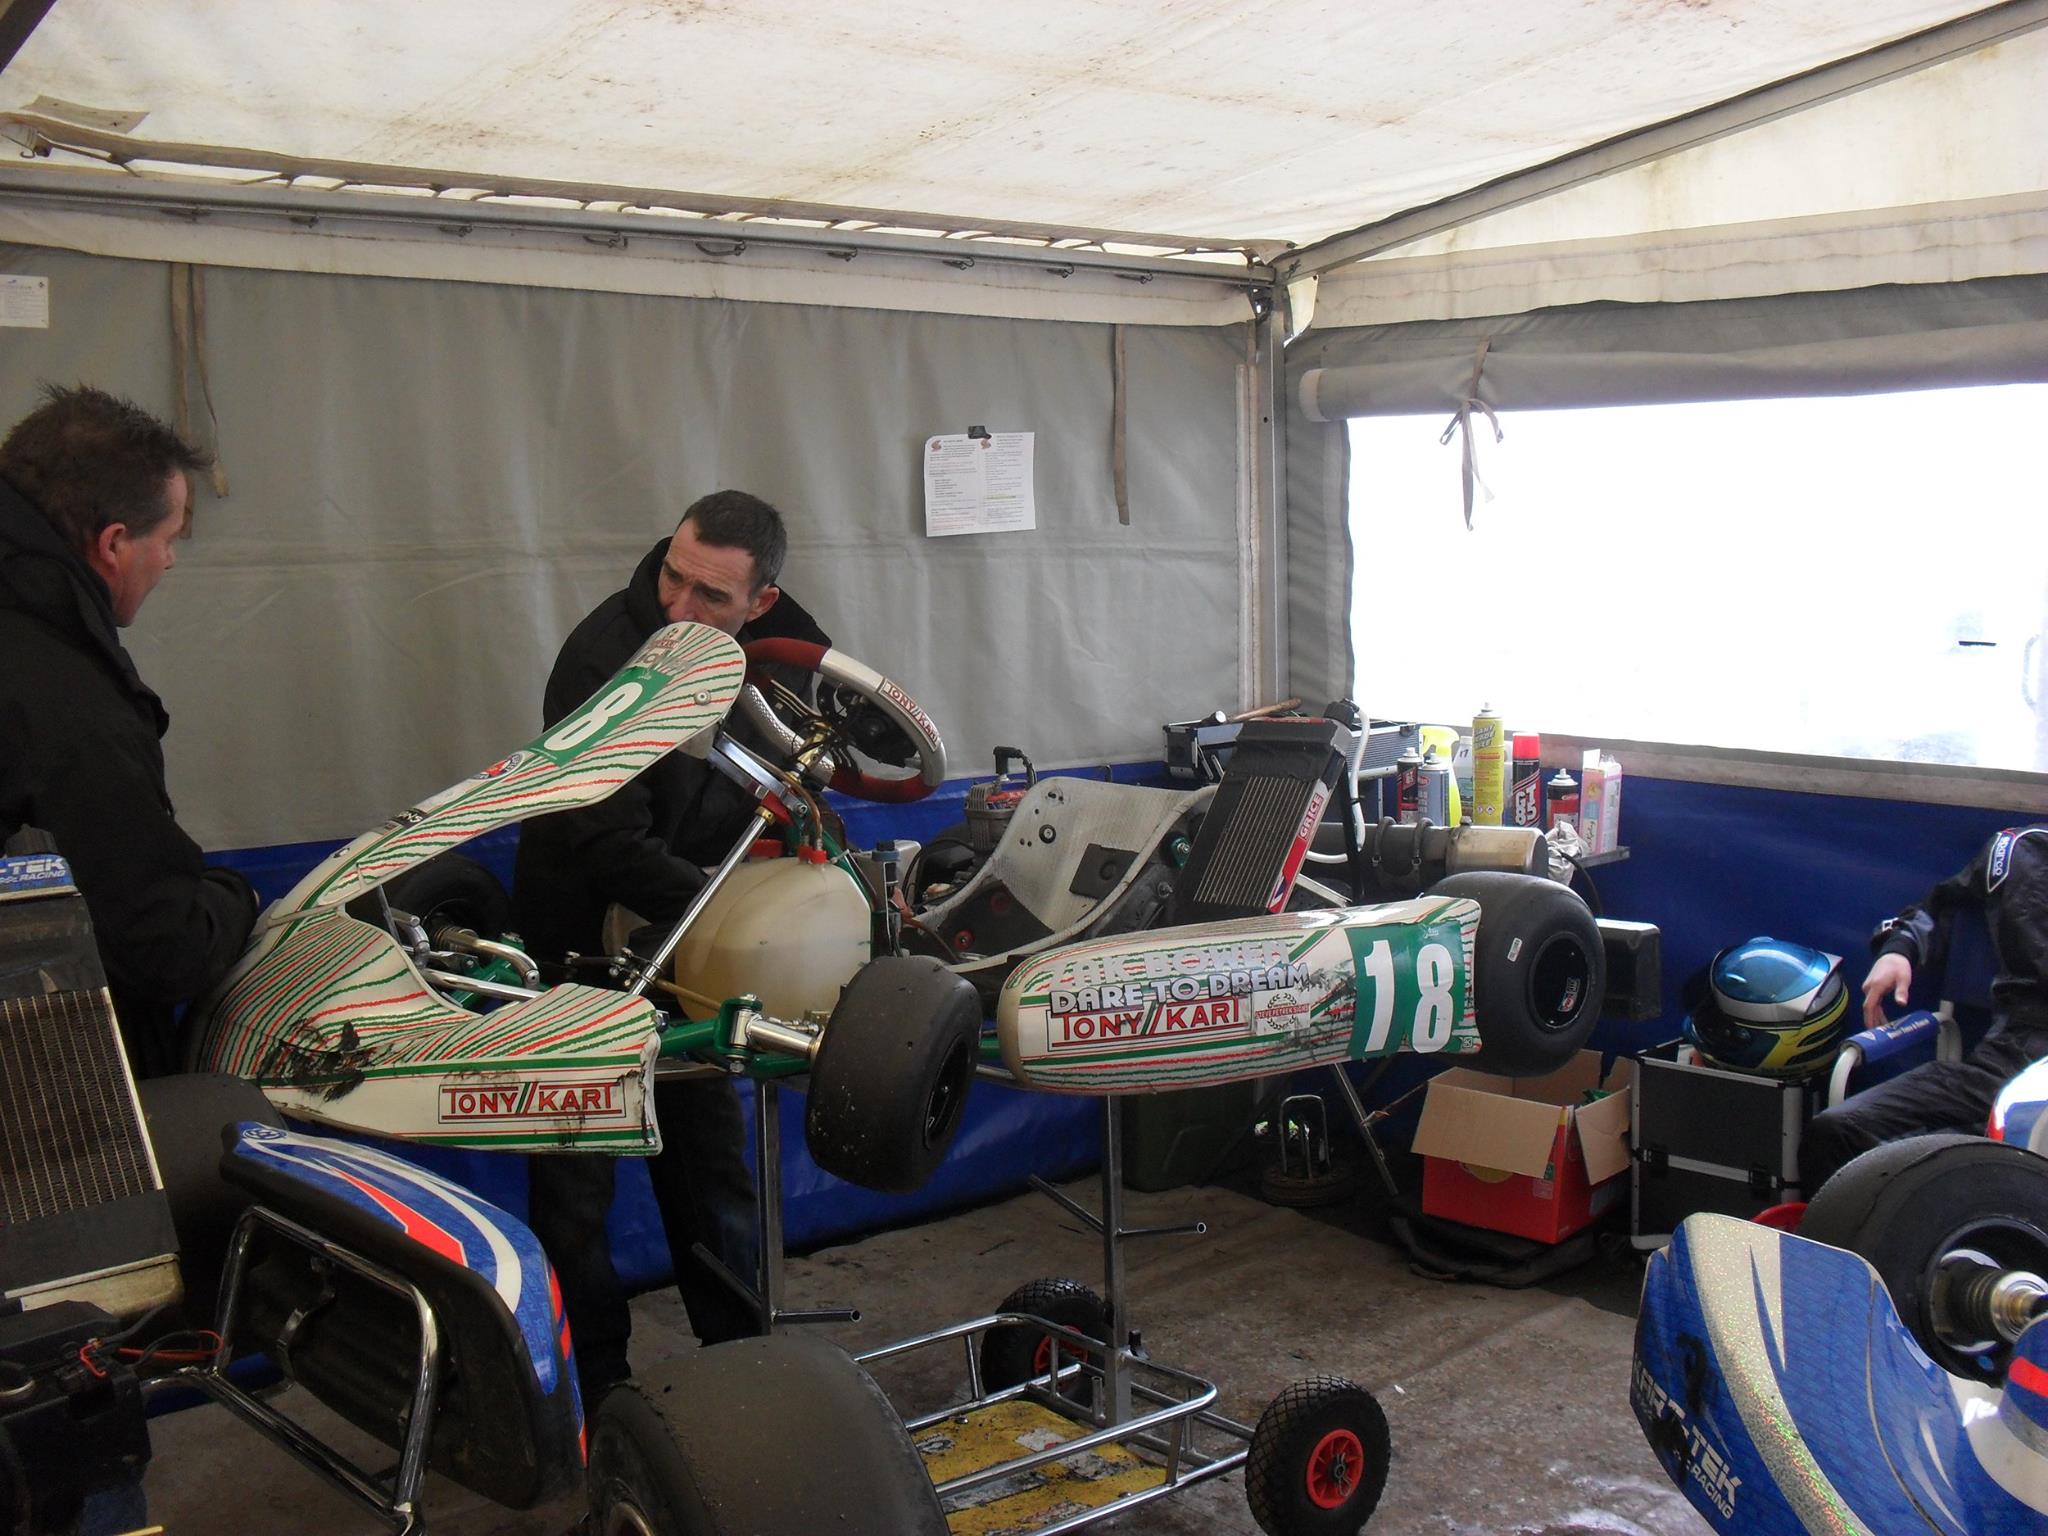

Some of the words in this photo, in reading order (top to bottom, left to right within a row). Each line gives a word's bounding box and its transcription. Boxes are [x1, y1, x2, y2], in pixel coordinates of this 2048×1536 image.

[19, 869, 66, 882] RACING
[1144, 941, 1290, 978] BOWEN
[1050, 982, 1144, 1014] DARE
[1150, 976, 1201, 1002] TO
[1208, 962, 1310, 997] DREAM
[1363, 939, 1455, 1054] 18
[1055, 1008, 1144, 1041] TONY
[1166, 997, 1242, 1031] KART
[442, 1084, 519, 1115] TONY
[537, 1080, 622, 1112] KART
[1691, 1465, 1734, 1519] RACING
